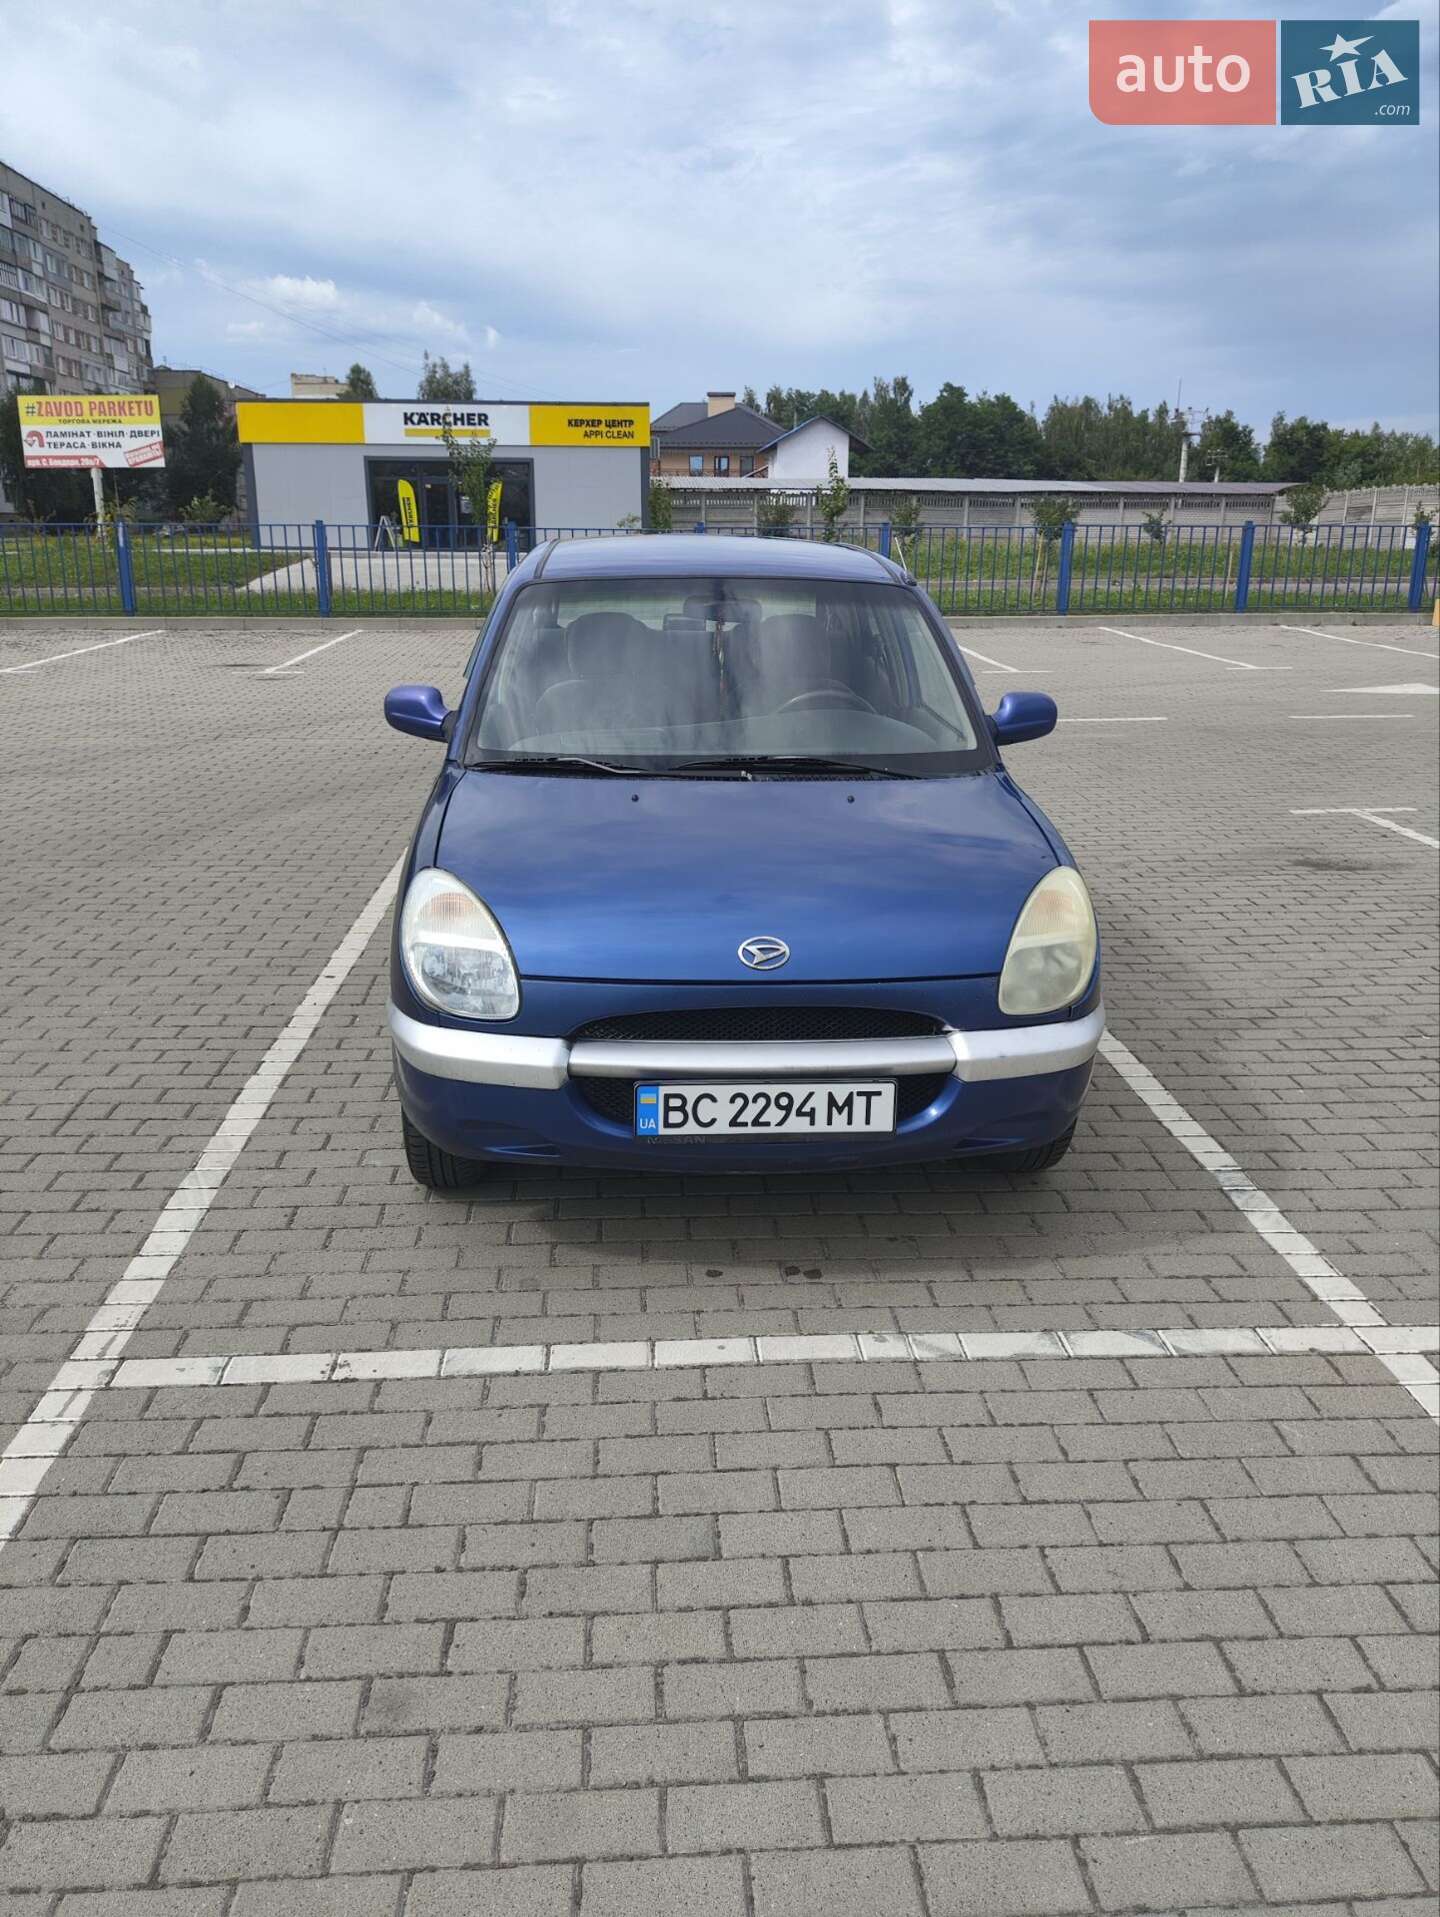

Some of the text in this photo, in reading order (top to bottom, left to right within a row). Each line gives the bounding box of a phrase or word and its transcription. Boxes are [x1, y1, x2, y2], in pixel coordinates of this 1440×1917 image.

[25, 400, 155, 417] #ZAVOD PARKETU
[403, 412, 489, 427] KÄRCHER
[567, 418, 634, 429] КЕРХЕР ЦЕНТР
[45, 430, 160, 439] ЛАМІНАТ ВІНІЛ ДВЕРІ
[605, 430, 634, 439] CLEAN
[46, 441, 122, 449] ТЕРАСА ВІКНА
[662, 1090, 883, 1129] BC 2294 MT
[639, 1117, 656, 1130] UA
